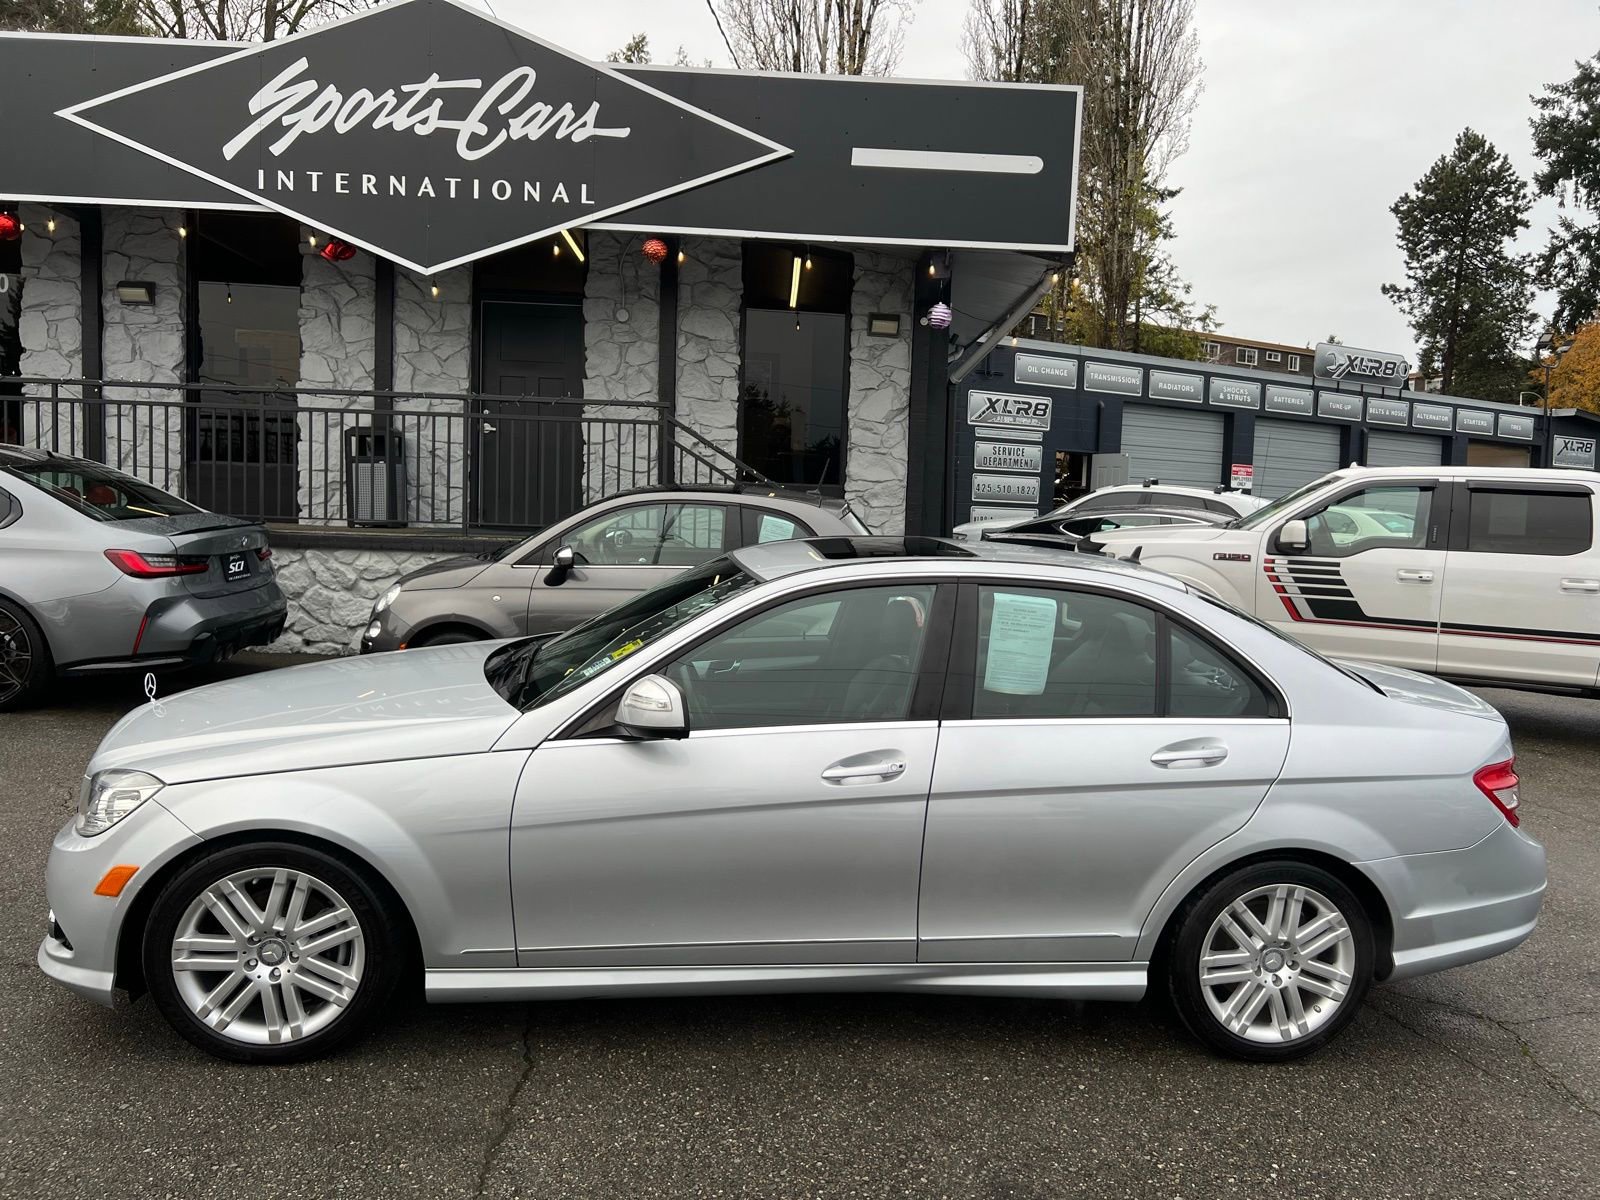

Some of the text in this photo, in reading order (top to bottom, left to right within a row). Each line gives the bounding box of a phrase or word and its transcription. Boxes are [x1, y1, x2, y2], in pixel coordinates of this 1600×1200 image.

[222, 56, 631, 161] Sports Cars
[257, 168, 596, 205] INTERNATIONAL
[1027, 365, 1068, 377] OIL CHANGE
[1332, 353, 1398, 379] XLR8
[1089, 372, 1140, 385] TRANSMISSIONS
[1158, 382, 1194, 393] RADIATORS
[1222, 385, 1249, 395] SHOCKS
[1226, 393, 1251, 403] STRUTS
[1273, 395, 1305, 406] BATTERIES
[973, 396, 1050, 420] XLR8
[1329, 402, 1352, 411] TUNE-UP
[1369, 407, 1385, 415] BELTS
[1416, 412, 1449, 422] ALTERNATOR
[1463, 418, 1488, 427] STARTERS
[992, 445, 1026, 457] SERVICE
[1556, 439, 1593, 456] XLR8
[982, 456, 1034, 468] DEPARTMENT
[975, 483, 1037, 496] 425-510-1822
[228, 560, 245, 574] SCI
